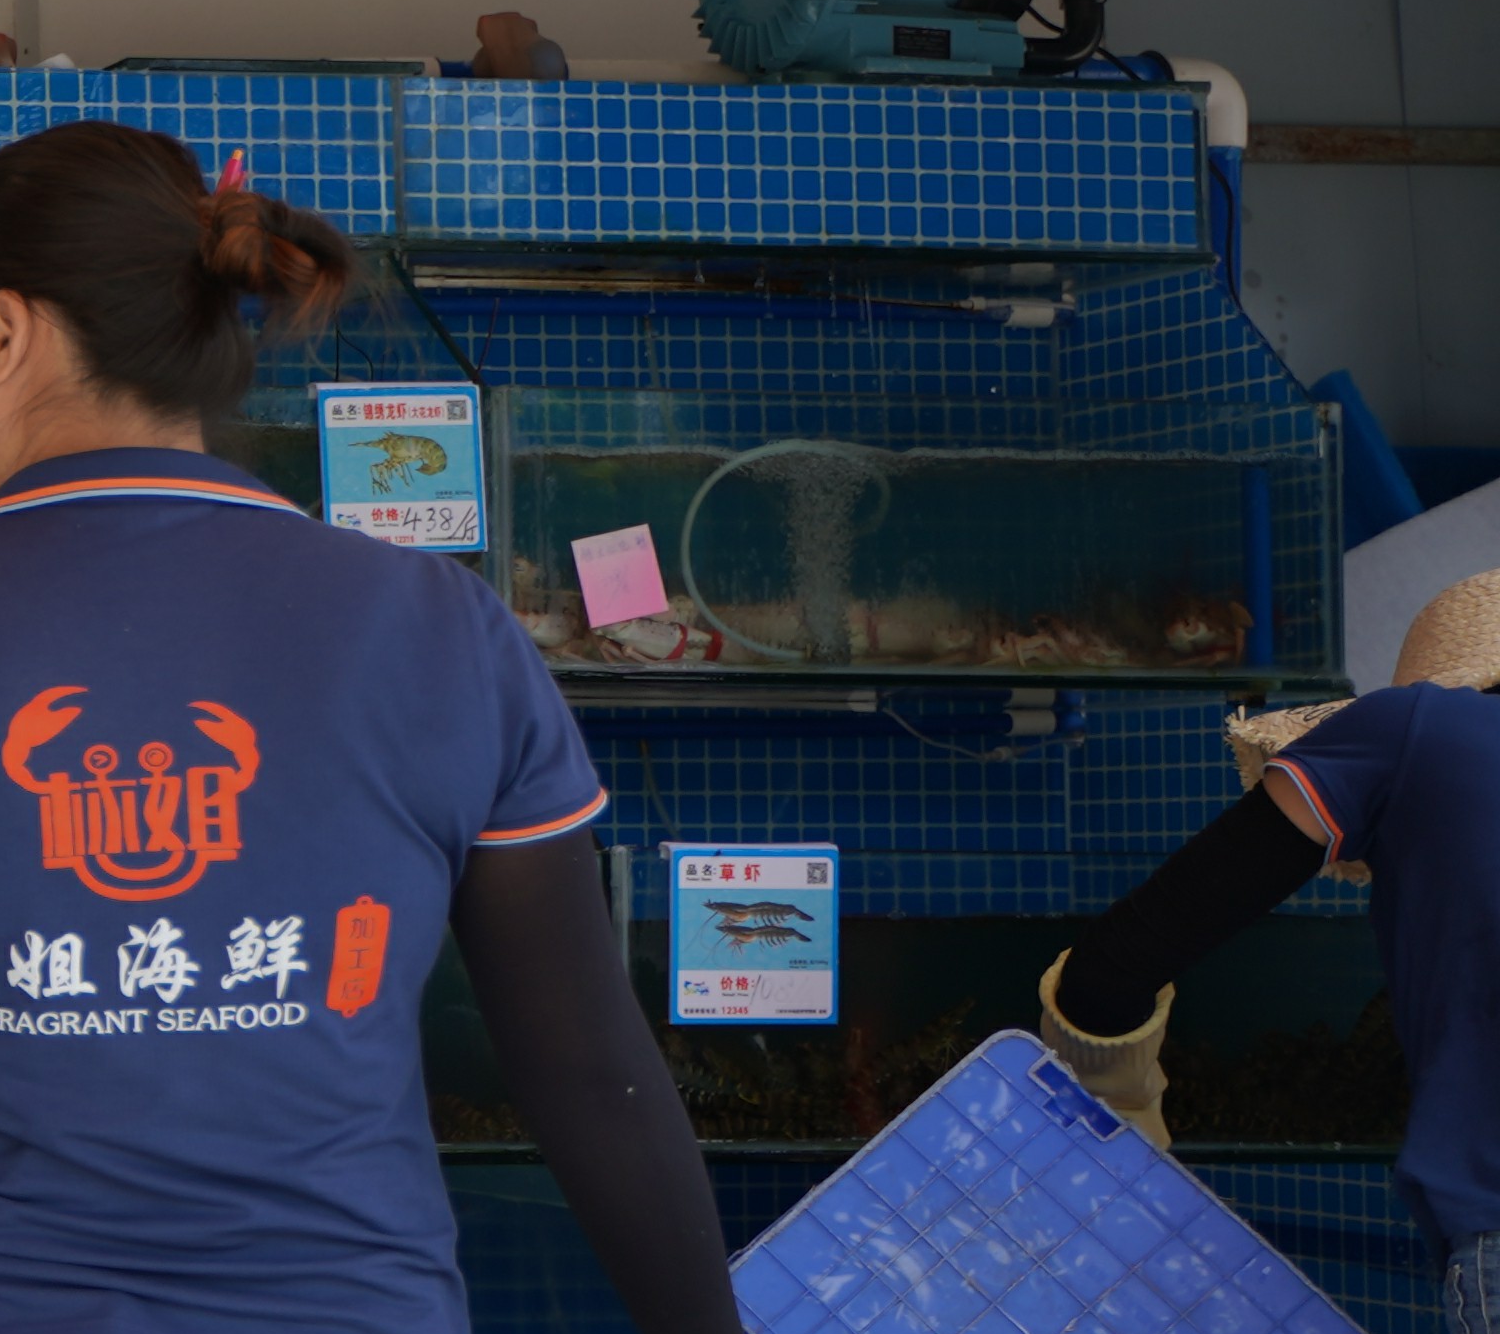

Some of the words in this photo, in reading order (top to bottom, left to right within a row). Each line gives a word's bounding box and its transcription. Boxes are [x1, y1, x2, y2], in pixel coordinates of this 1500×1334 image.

[370, 507, 404, 522] 价格:
[720, 974, 755, 991] 价格:
[156, 1001, 307, 1031] SEAFOOD
